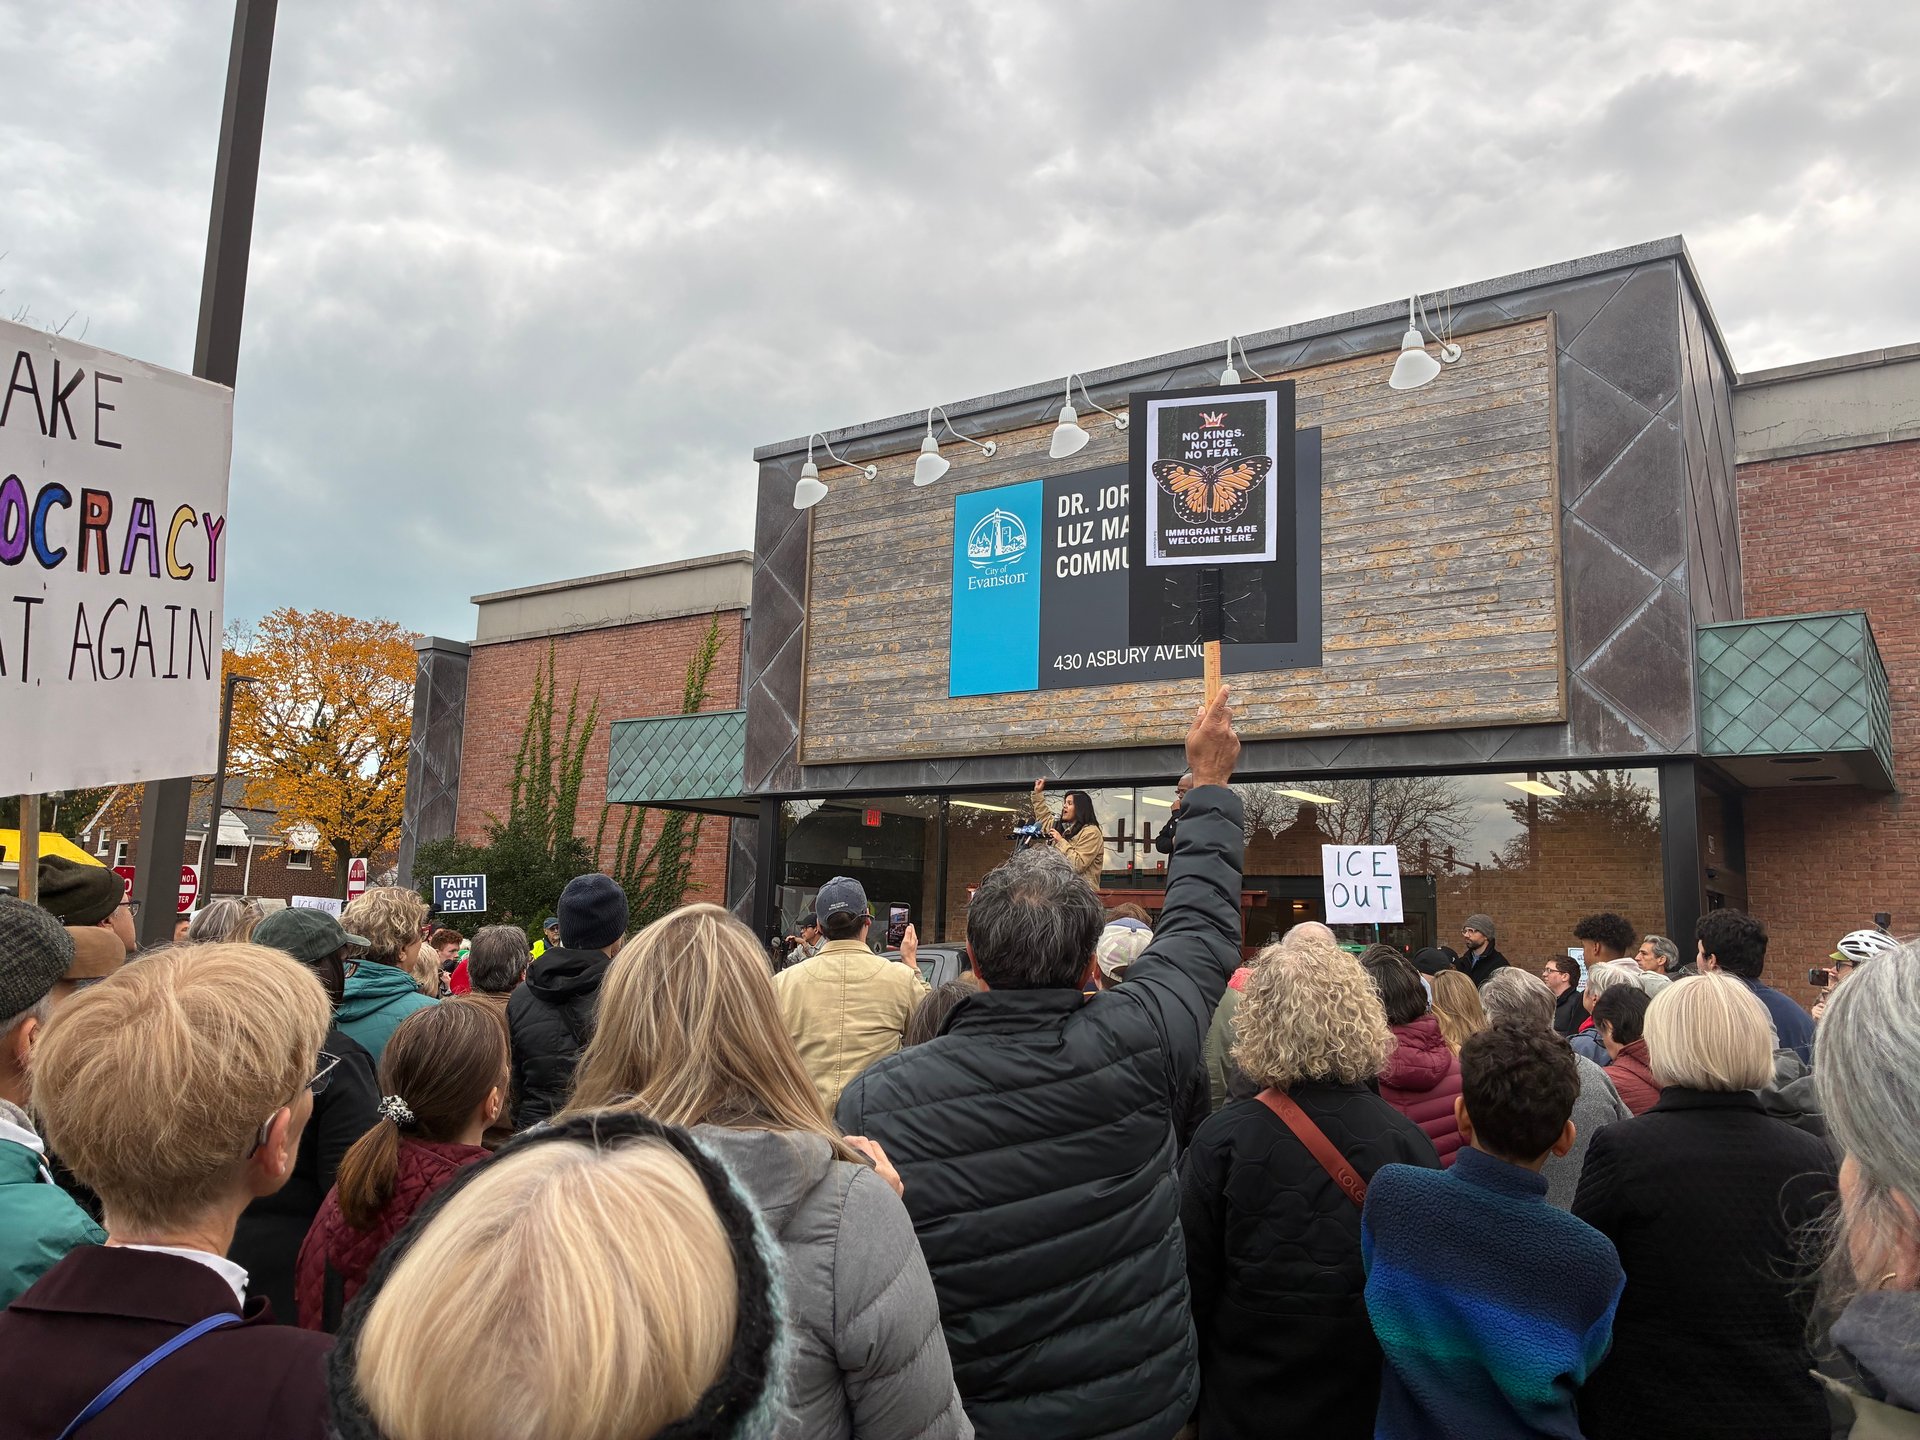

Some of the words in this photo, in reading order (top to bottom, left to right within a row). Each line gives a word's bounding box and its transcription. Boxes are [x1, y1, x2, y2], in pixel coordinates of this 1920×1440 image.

[0, 351, 123, 449] AKE
[1182, 431, 1200, 441] NO
[1203, 428, 1245, 440] KINGS.
[1191, 440, 1209, 450] NO
[1212, 438, 1236, 448] ICE.
[1185, 450, 1202, 459] NO
[1206, 447, 1242, 458] FEAR.
[1058, 493, 1090, 518] DR.
[0, 474, 225, 582] OCRACY
[1057, 520, 1094, 548] LUZ
[1165, 526, 1232, 537] IMMIGRANTS
[1236, 524, 1258, 533] ARE
[1168, 535, 1221, 545] WELCOME
[1224, 533, 1255, 543] HERE.
[985, 567, 999, 576] City
[1000, 564, 1008, 573] of
[968, 572, 1026, 590] Evanston
[68, 598, 213, 681] AGAIN
[1053, 653, 1082, 671] 430
[1086, 646, 1150, 669] ASBURY
[1337, 850, 1392, 877] ICE
[181, 874, 195, 883] NOT
[440, 877, 478, 889] FAITH
[445, 889, 474, 899] OVER
[1332, 883, 1392, 910] OUT
[443, 899, 477, 911] FEAR
